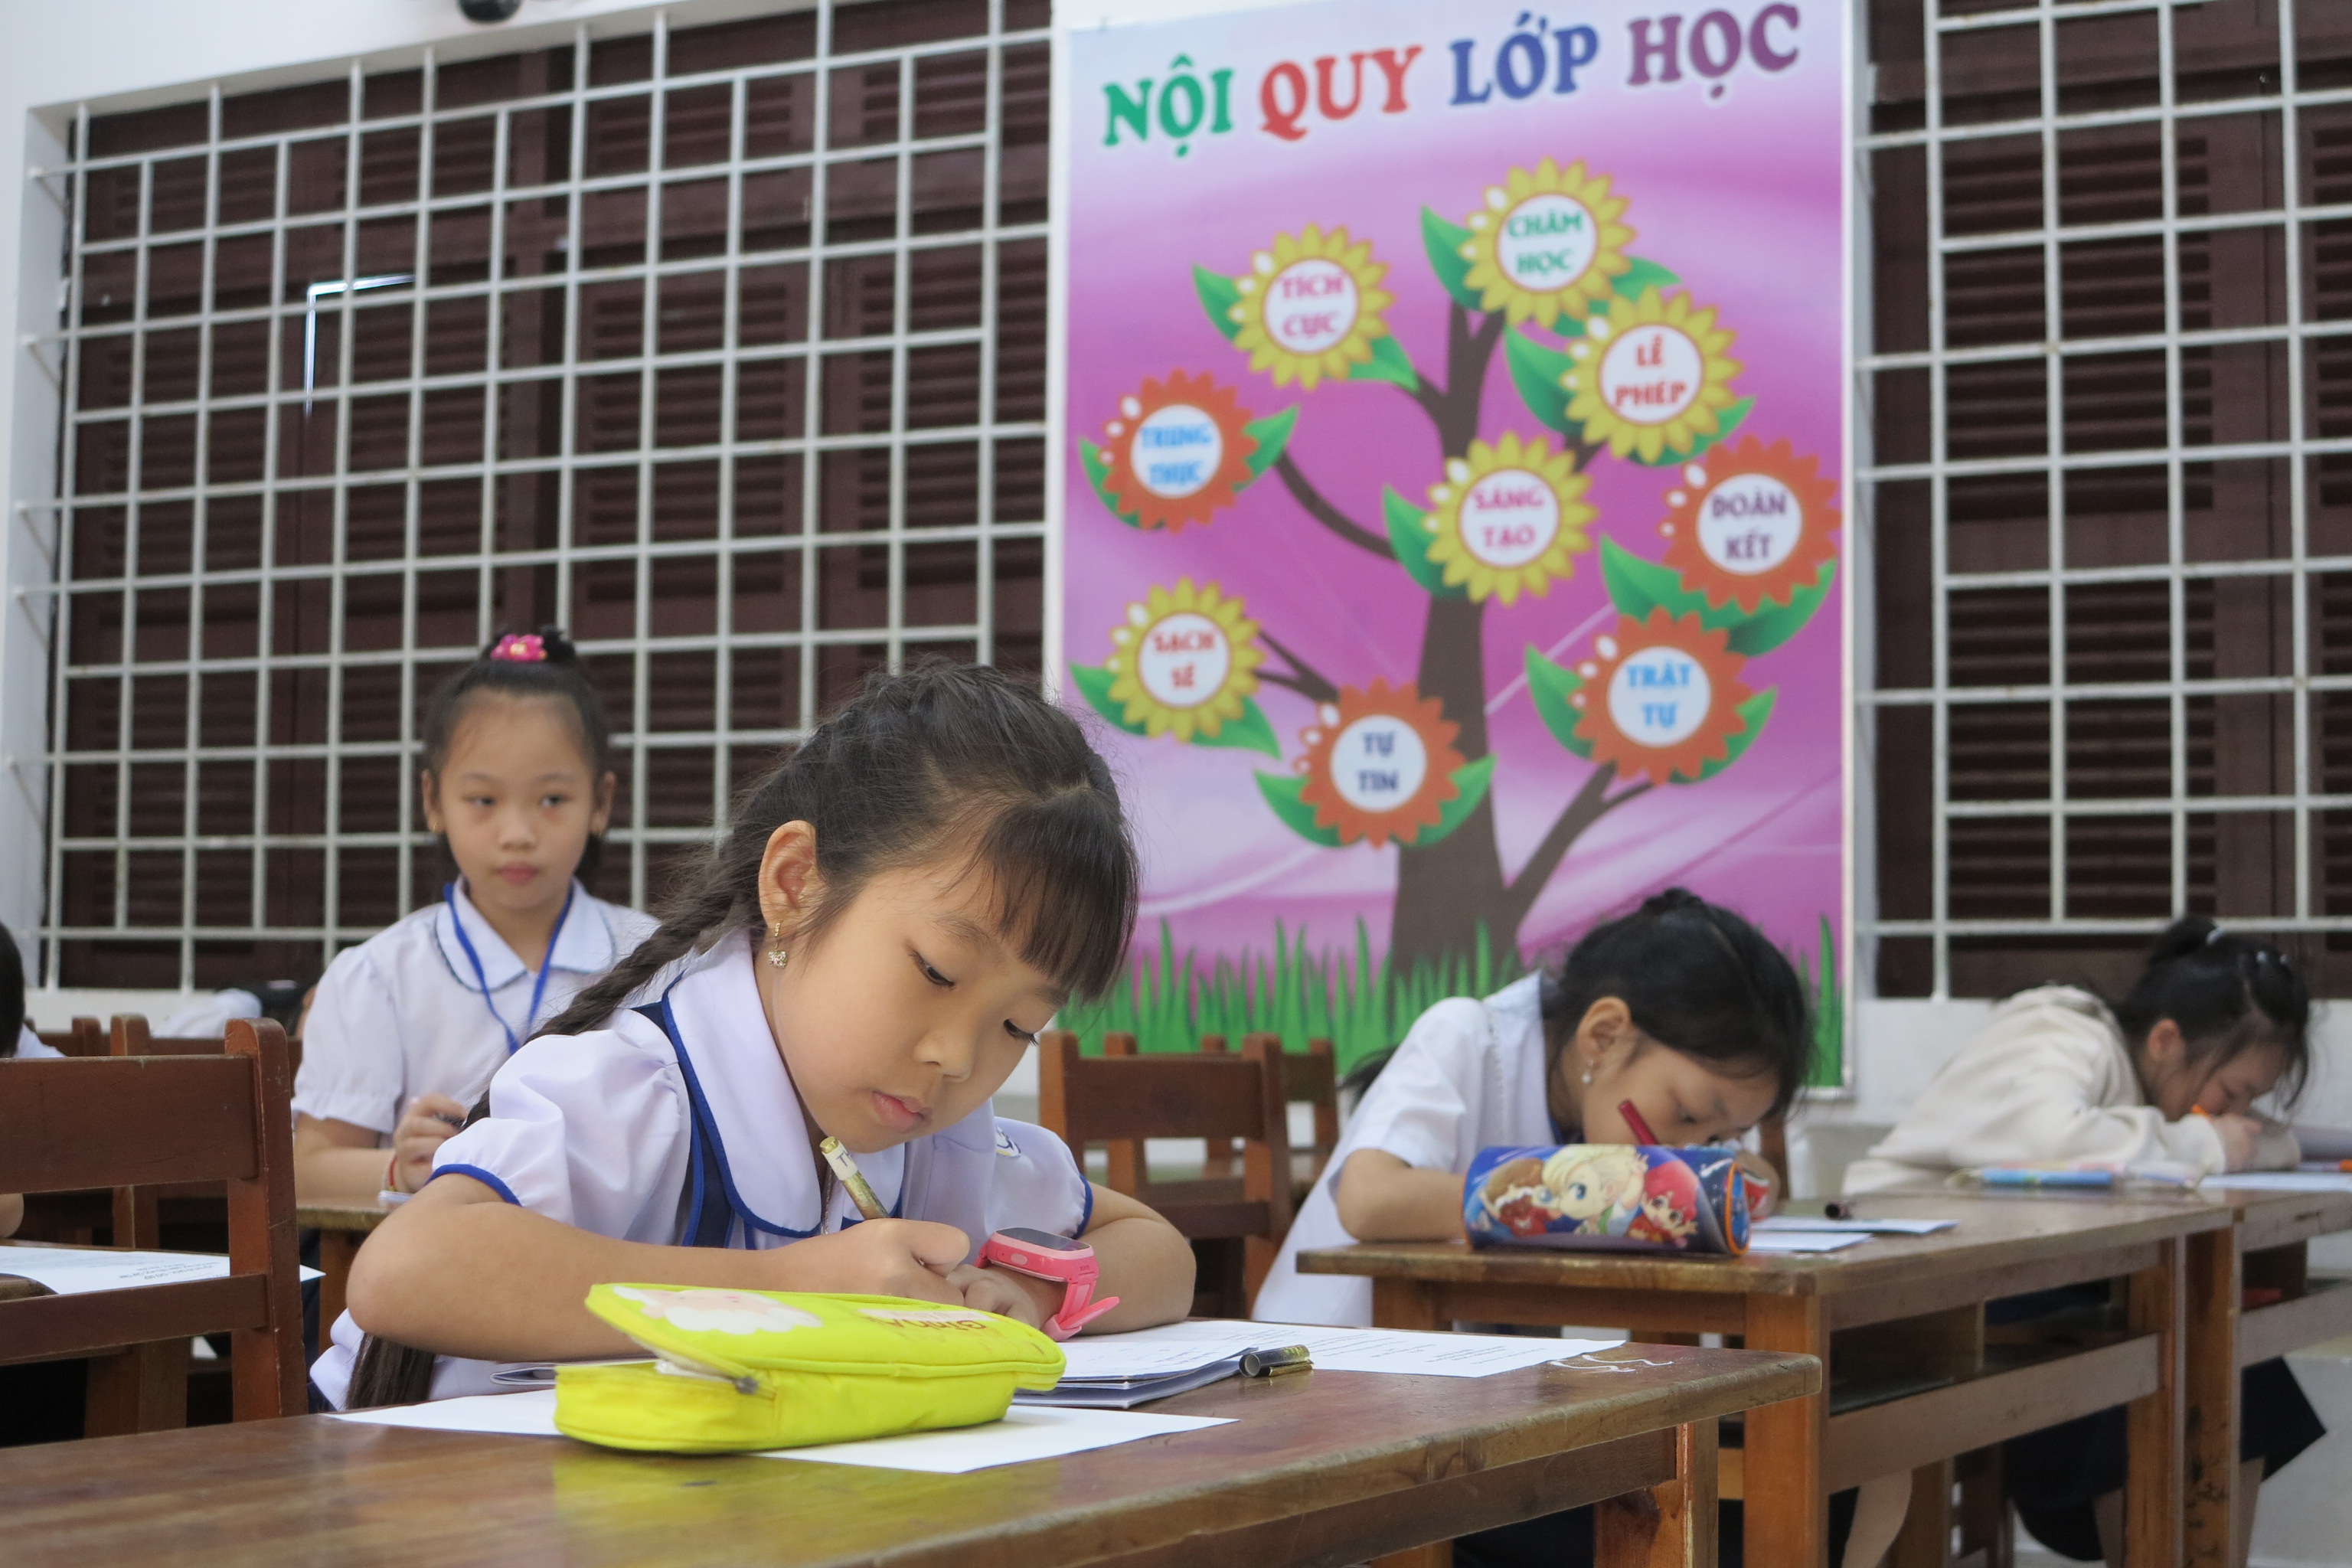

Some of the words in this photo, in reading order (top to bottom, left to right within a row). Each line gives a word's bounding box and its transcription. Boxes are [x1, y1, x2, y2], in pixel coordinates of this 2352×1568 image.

[1102, 54, 1233, 158] NỘI
[1260, 46, 1422, 141] QUY
[1449, 11, 1599, 105] LỚP
[1628, 3, 1799, 98] HỌC
[1357, 769, 1400, 793] TIN
